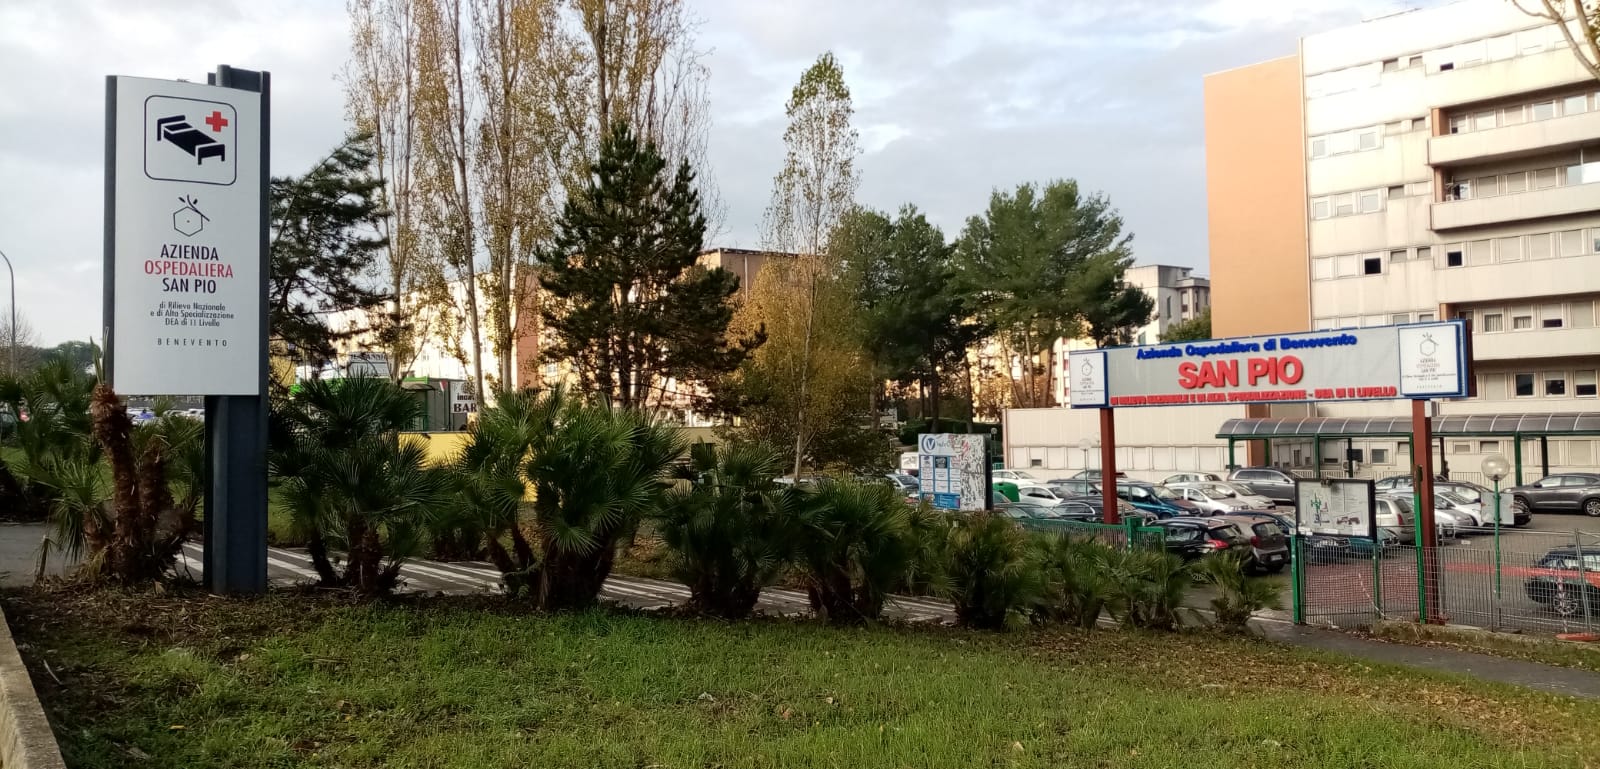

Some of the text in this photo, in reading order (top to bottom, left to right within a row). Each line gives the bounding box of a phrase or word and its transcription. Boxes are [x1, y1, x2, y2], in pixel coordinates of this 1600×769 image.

[160, 243, 219, 261] AZIENDA
[144, 260, 234, 278] OSPEDALIERA
[162, 277, 216, 294] SAN PIO
[159, 301, 226, 311] di Rilievo Nazionale
[156, 309, 163, 317] di
[165, 309, 179, 317] Alta
[181, 310, 234, 319] Specializzazione
[165, 317, 179, 326] DEA
[199, 319, 220, 327] Livello
[157, 337, 227, 347] BENEVENTO
[1137, 333, 1358, 360] Azienda Ospedaliera di Benevento
[1178, 355, 1304, 389] SAN PIO
[453, 403, 477, 412] BAR
